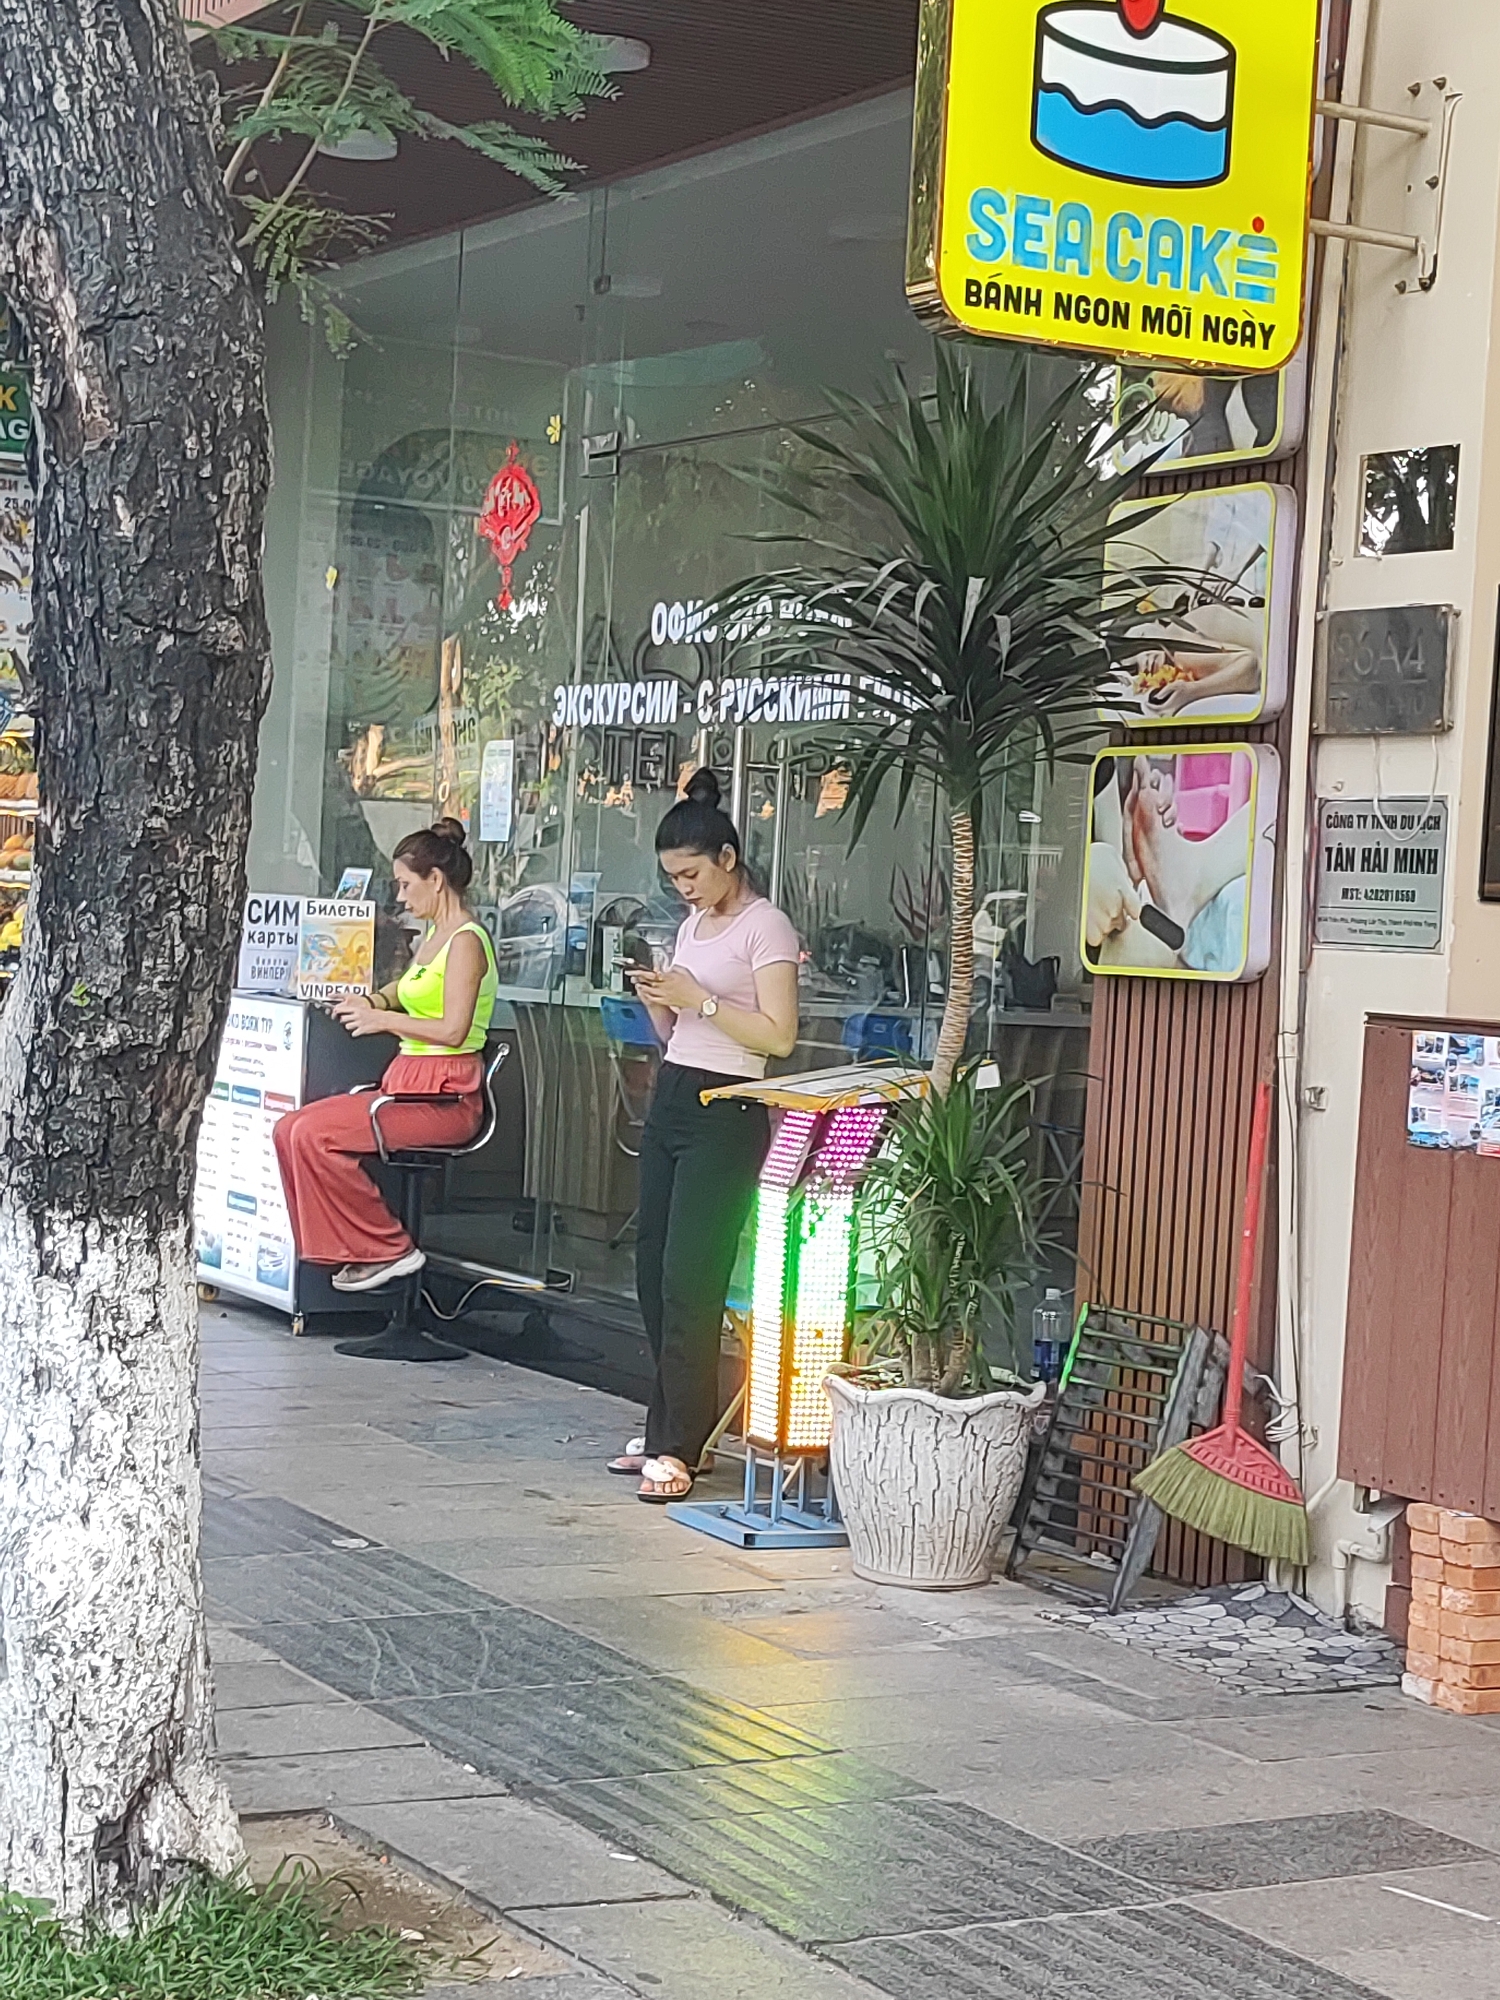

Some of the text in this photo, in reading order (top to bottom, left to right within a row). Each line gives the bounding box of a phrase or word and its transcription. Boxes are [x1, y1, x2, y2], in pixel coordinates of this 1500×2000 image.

[966, 187, 1279, 304] SEA CAKE
[964, 272, 1276, 350] BÁNH NGON MỖI NGÀY
[552, 680, 679, 728] ЭКСКУРСИИ
[719, 673, 851, 724] РУССКИМИ
[1326, 811, 1354, 830] CÔNG
[1356, 814, 1369, 830] TY
[1400, 815, 1415, 831] DU
[1325, 840, 1439, 875] TÂN HẢI MINH
[248, 898, 300, 927] СИМ
[306, 900, 370, 918] Билеты
[247, 930, 299, 949] карты
